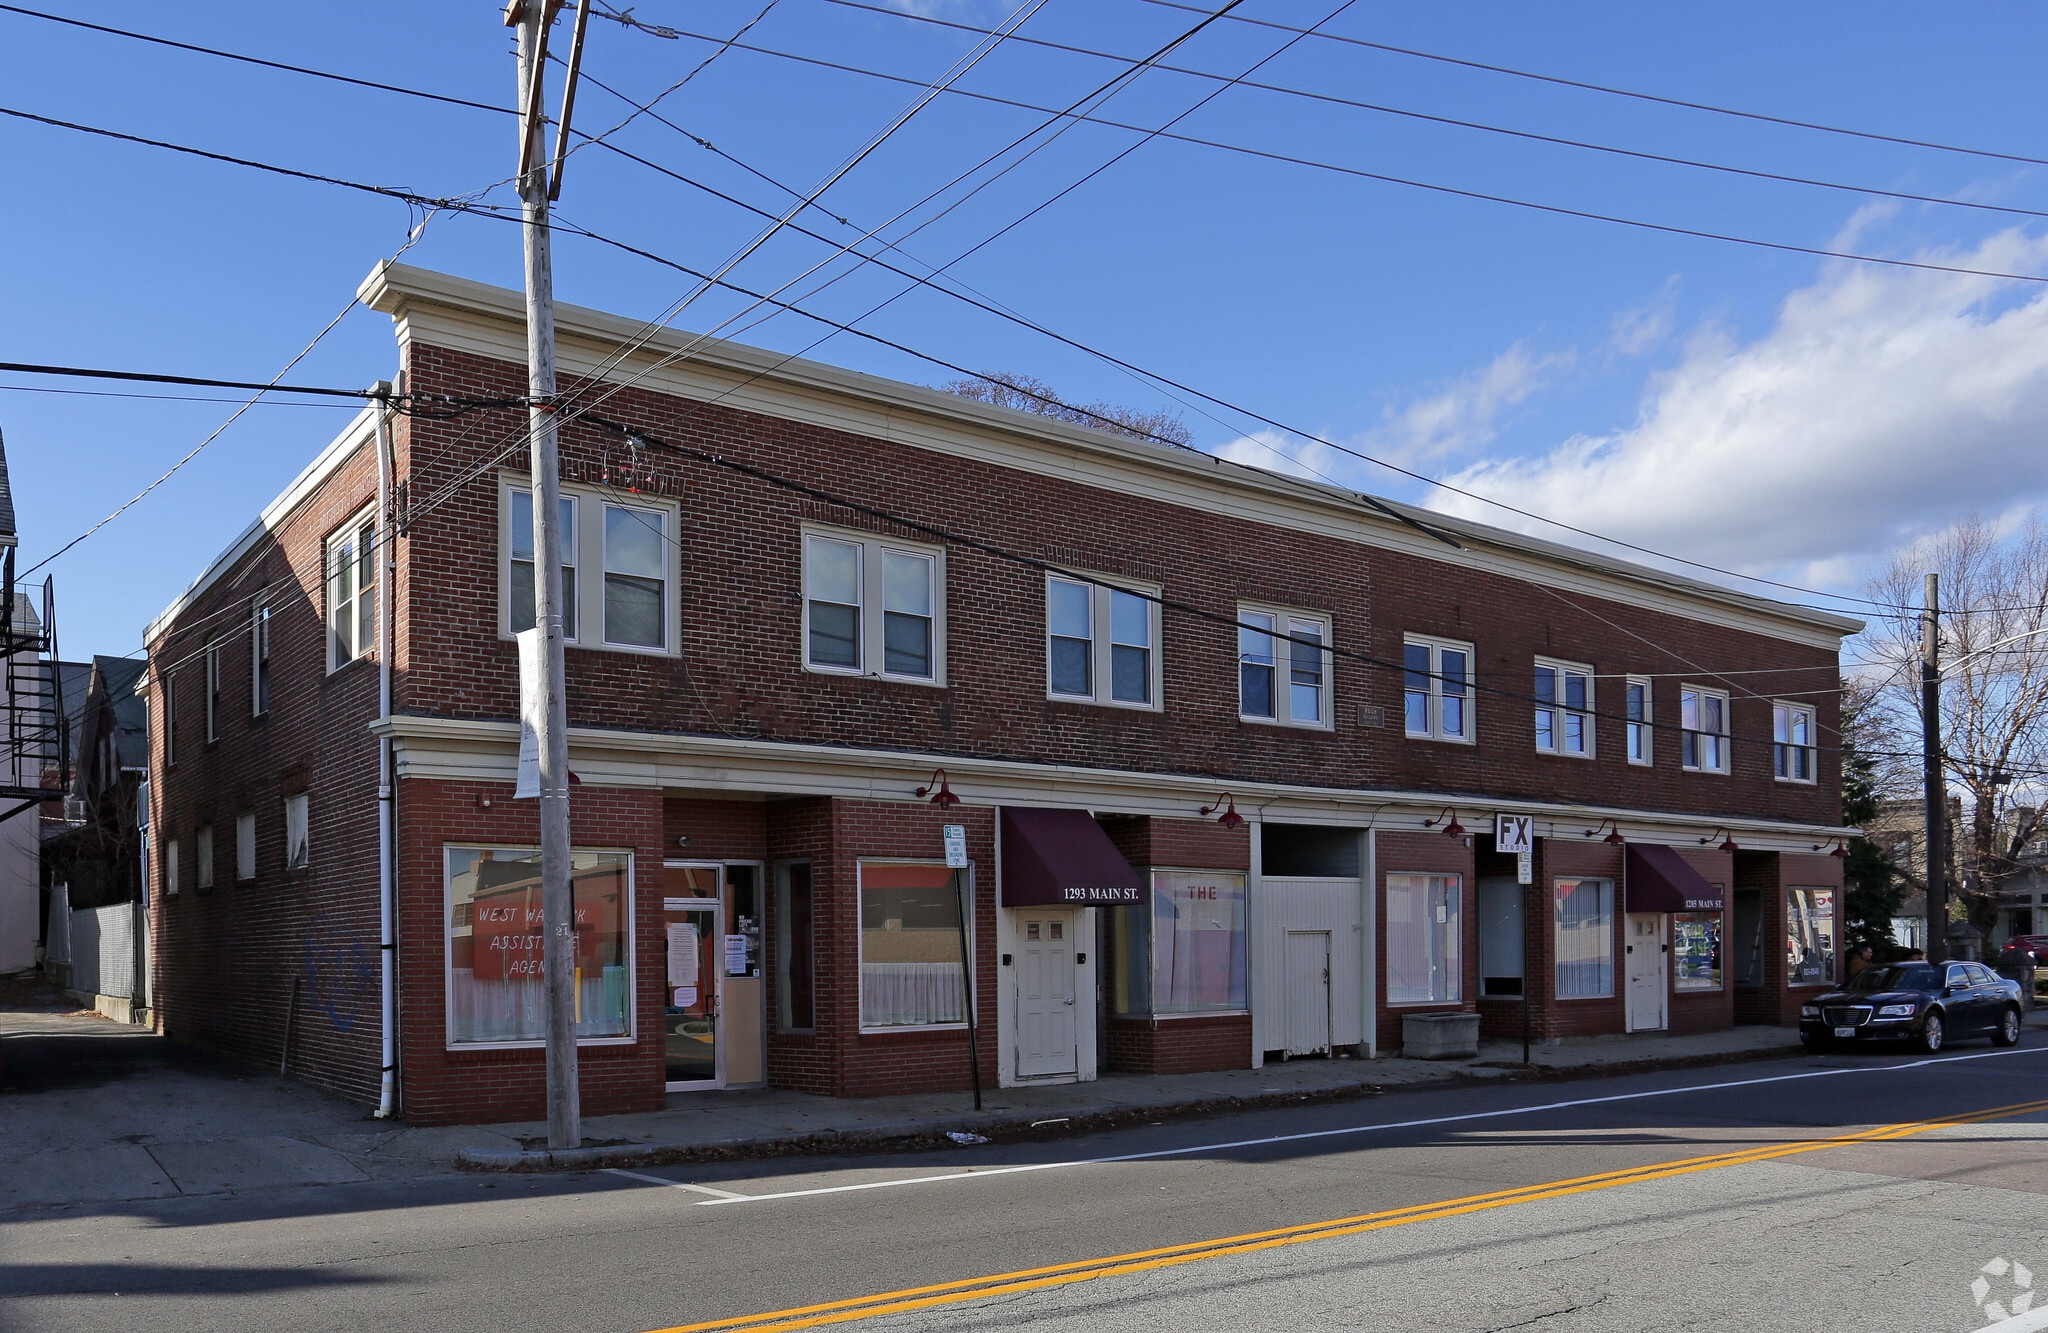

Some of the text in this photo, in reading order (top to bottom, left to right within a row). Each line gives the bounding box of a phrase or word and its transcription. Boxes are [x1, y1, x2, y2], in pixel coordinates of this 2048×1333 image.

[1500, 816, 1529, 845] FX
[1064, 888, 1139, 900] 1293 MAIN ST.
[1187, 886, 1217, 900] THE
[1685, 900, 1724, 908] 1285 MAIN ST.
[479, 908, 517, 922] WEST
